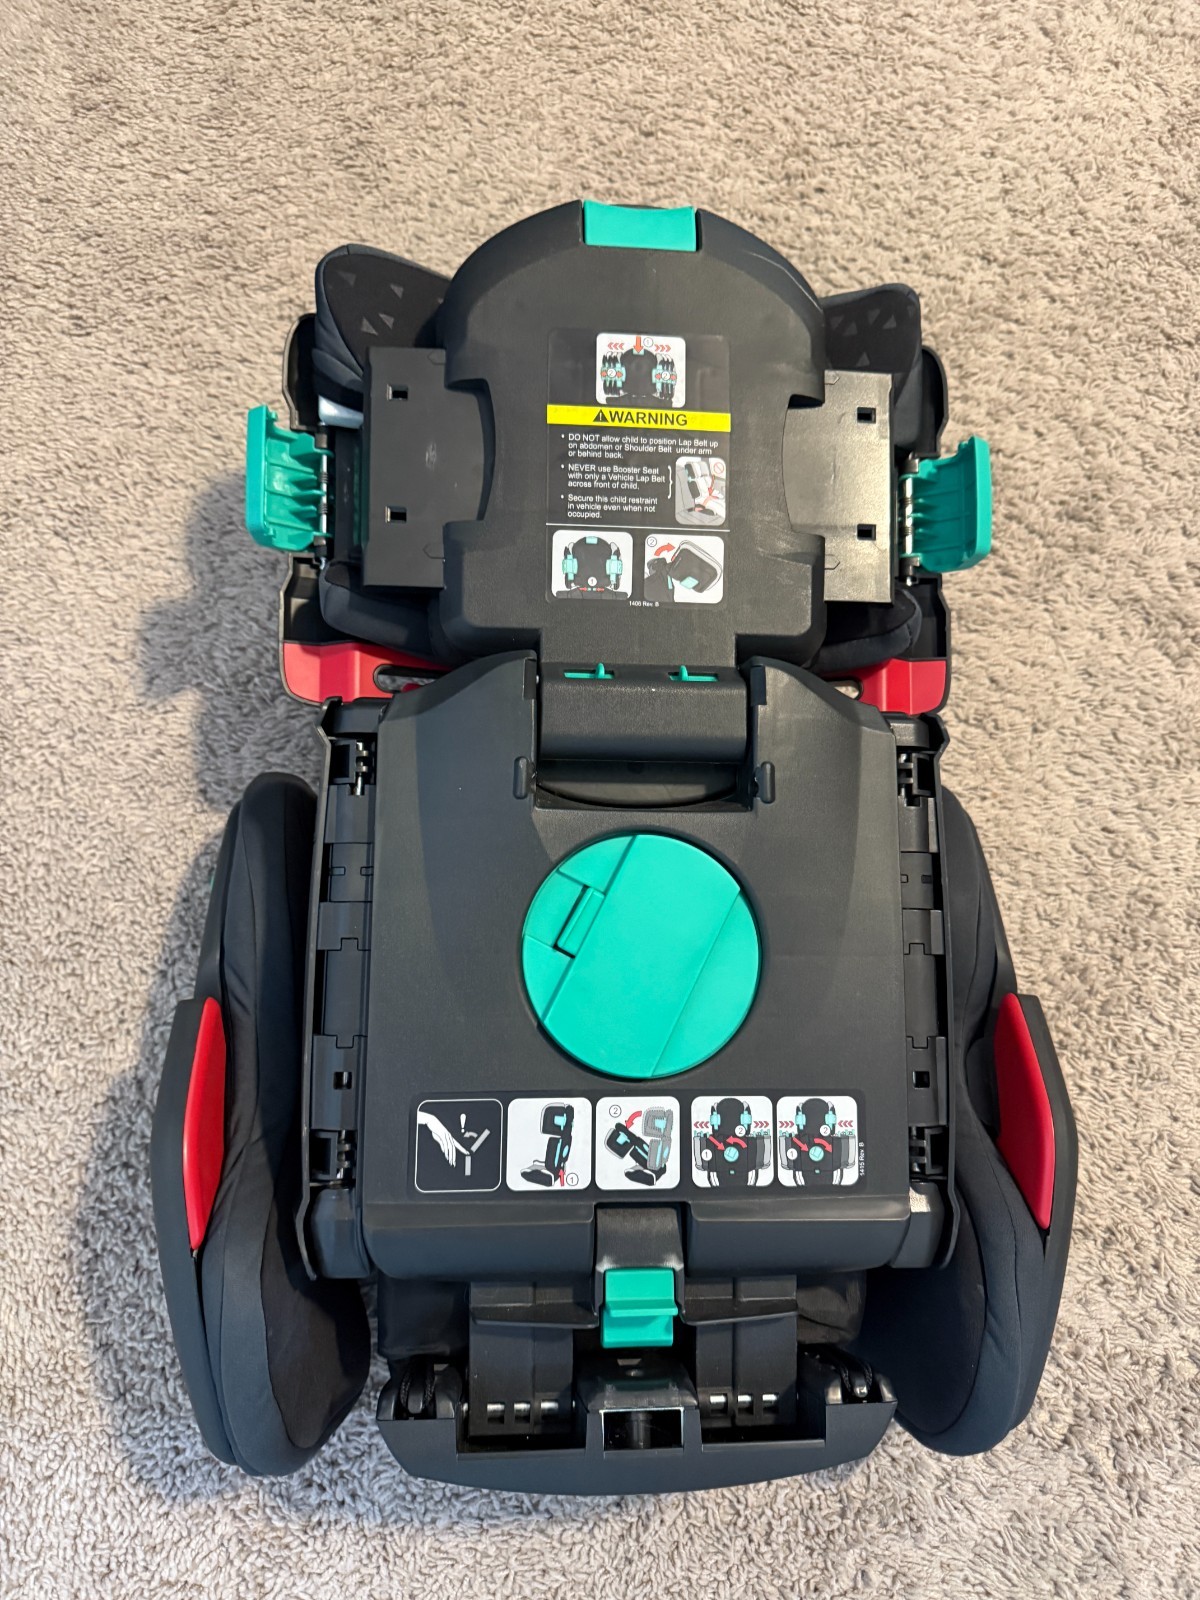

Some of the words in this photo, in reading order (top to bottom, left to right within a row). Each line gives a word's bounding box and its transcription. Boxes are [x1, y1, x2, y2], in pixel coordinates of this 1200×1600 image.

[609, 410, 687, 426] WARNING
[624, 444, 656, 452] Shoulder
[585, 474, 599, 482] only
[608, 473, 634, 481] Vehicle
[636, 475, 649, 483] Lap
[568, 511, 602, 519] occupied.
